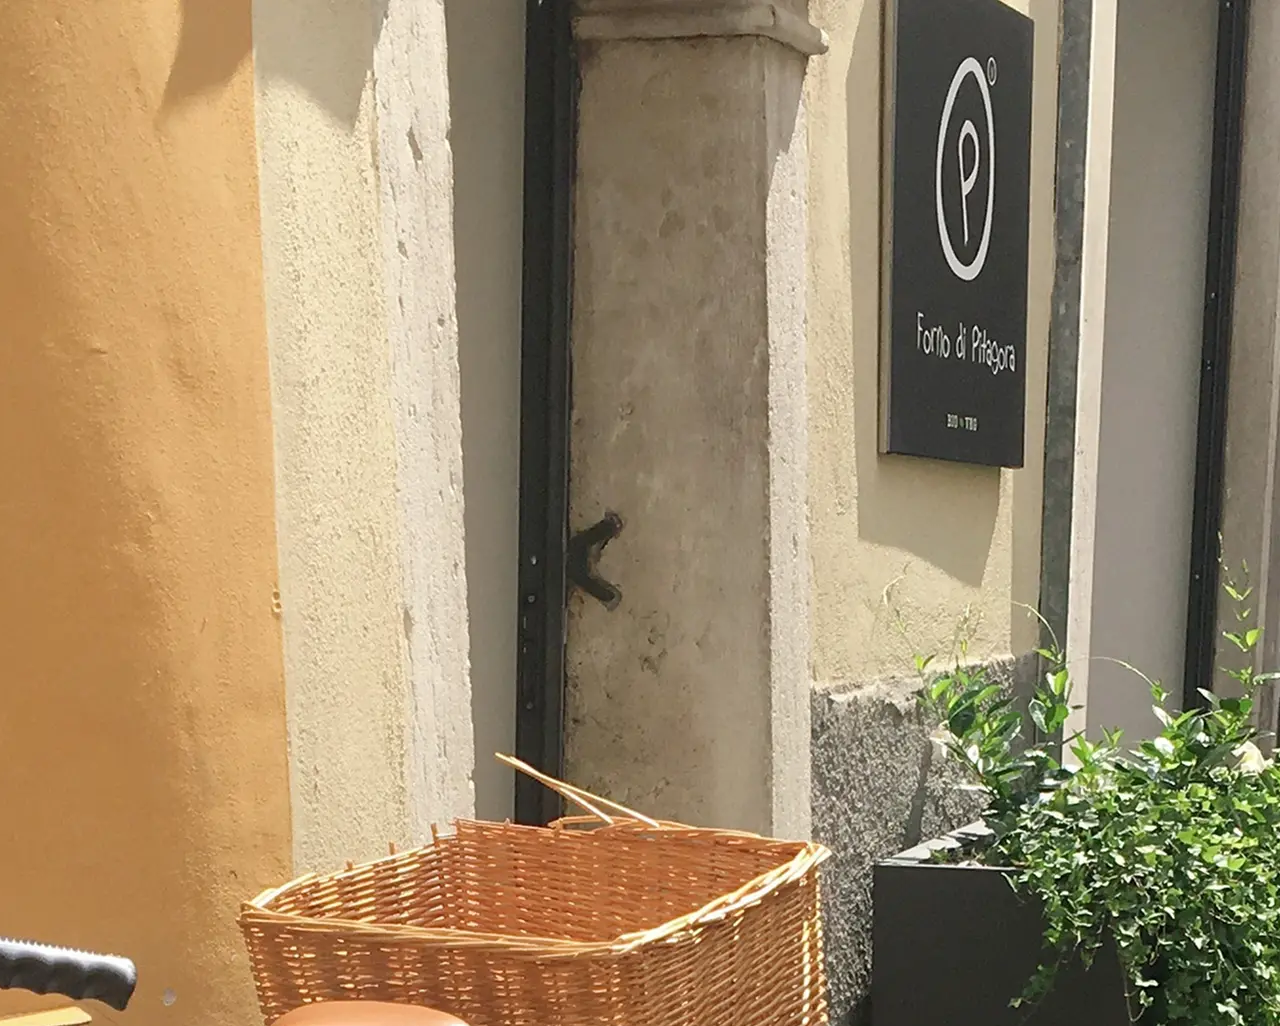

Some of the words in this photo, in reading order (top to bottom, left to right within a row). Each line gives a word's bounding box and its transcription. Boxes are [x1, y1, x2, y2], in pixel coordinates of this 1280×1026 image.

[917, 311, 951, 359] Forno
[955, 322, 967, 360] di
[972, 325, 1016, 375] Pitagora
